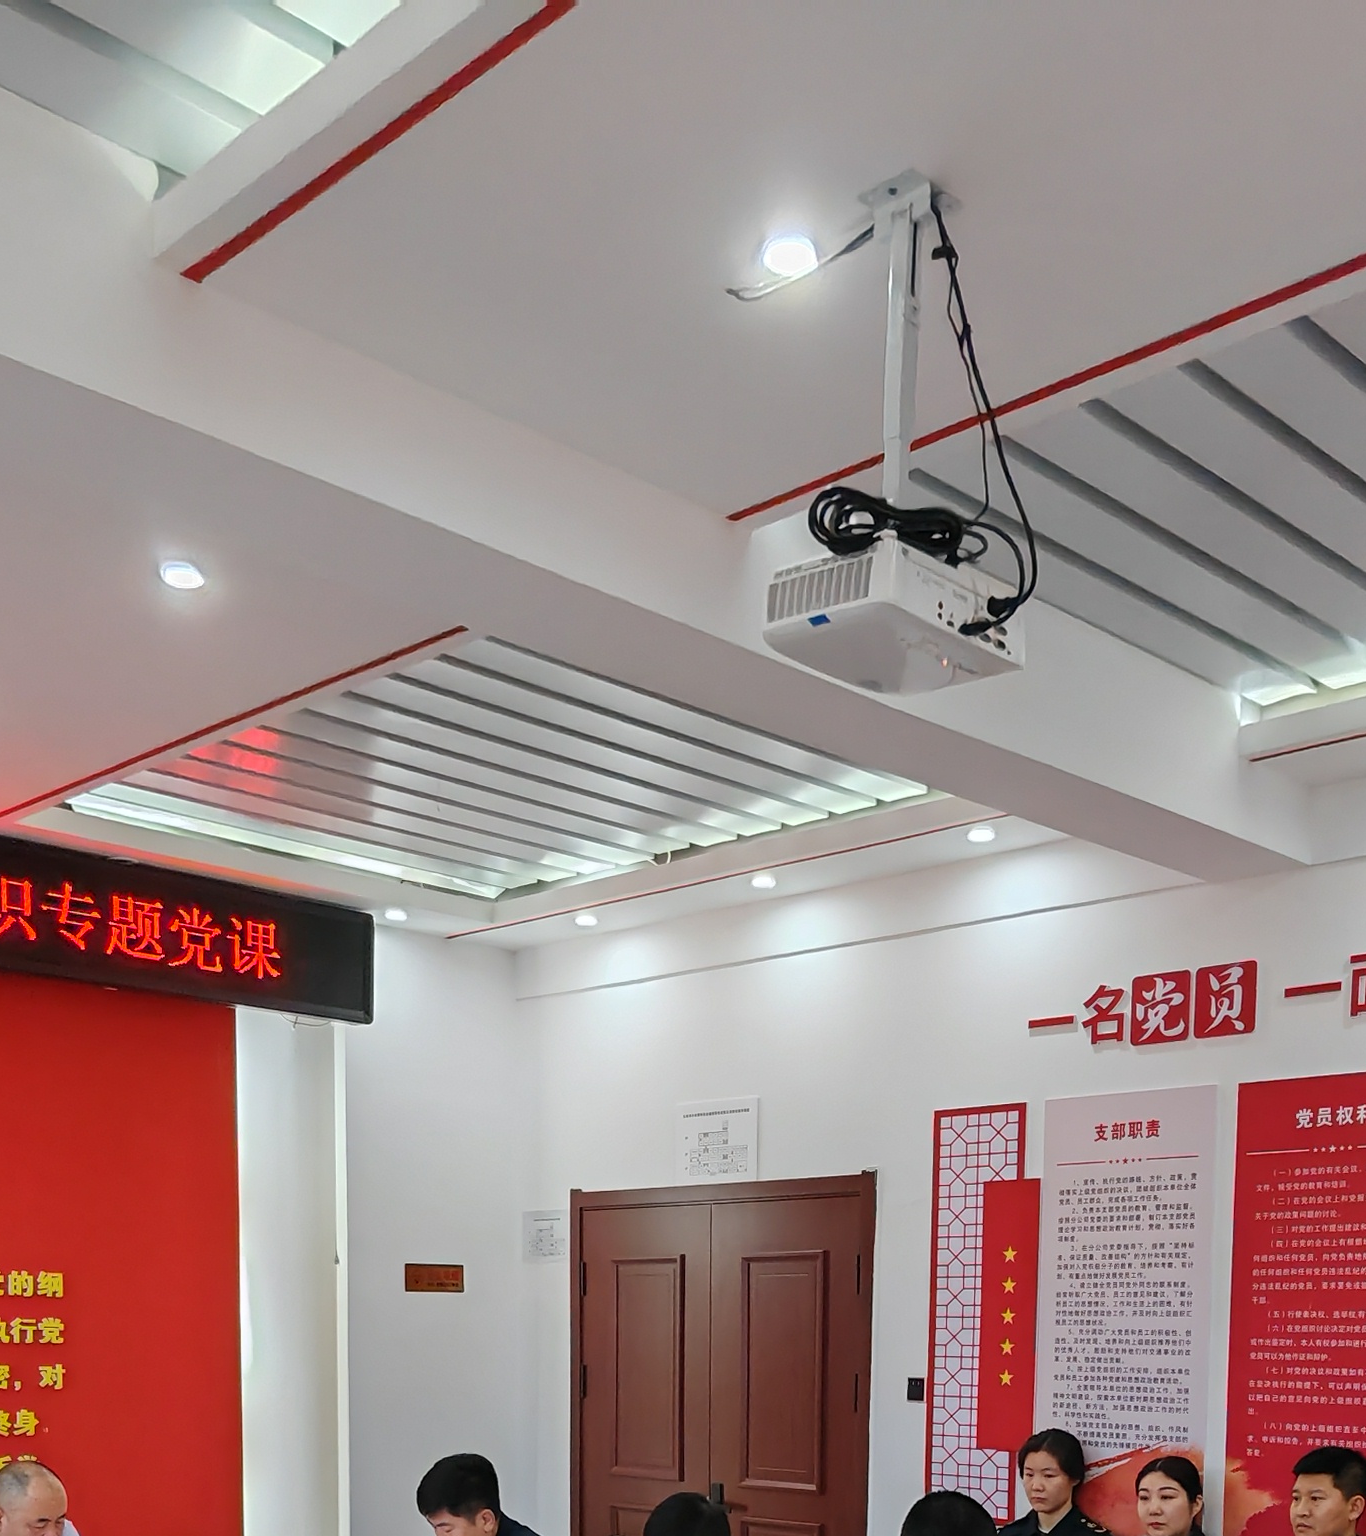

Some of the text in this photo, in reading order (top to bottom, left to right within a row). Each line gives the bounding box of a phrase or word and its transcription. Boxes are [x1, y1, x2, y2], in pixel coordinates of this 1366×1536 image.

[1027, 965, 1254, 1046] 一名党员
[1094, 1119, 1160, 1142] 支部职责
